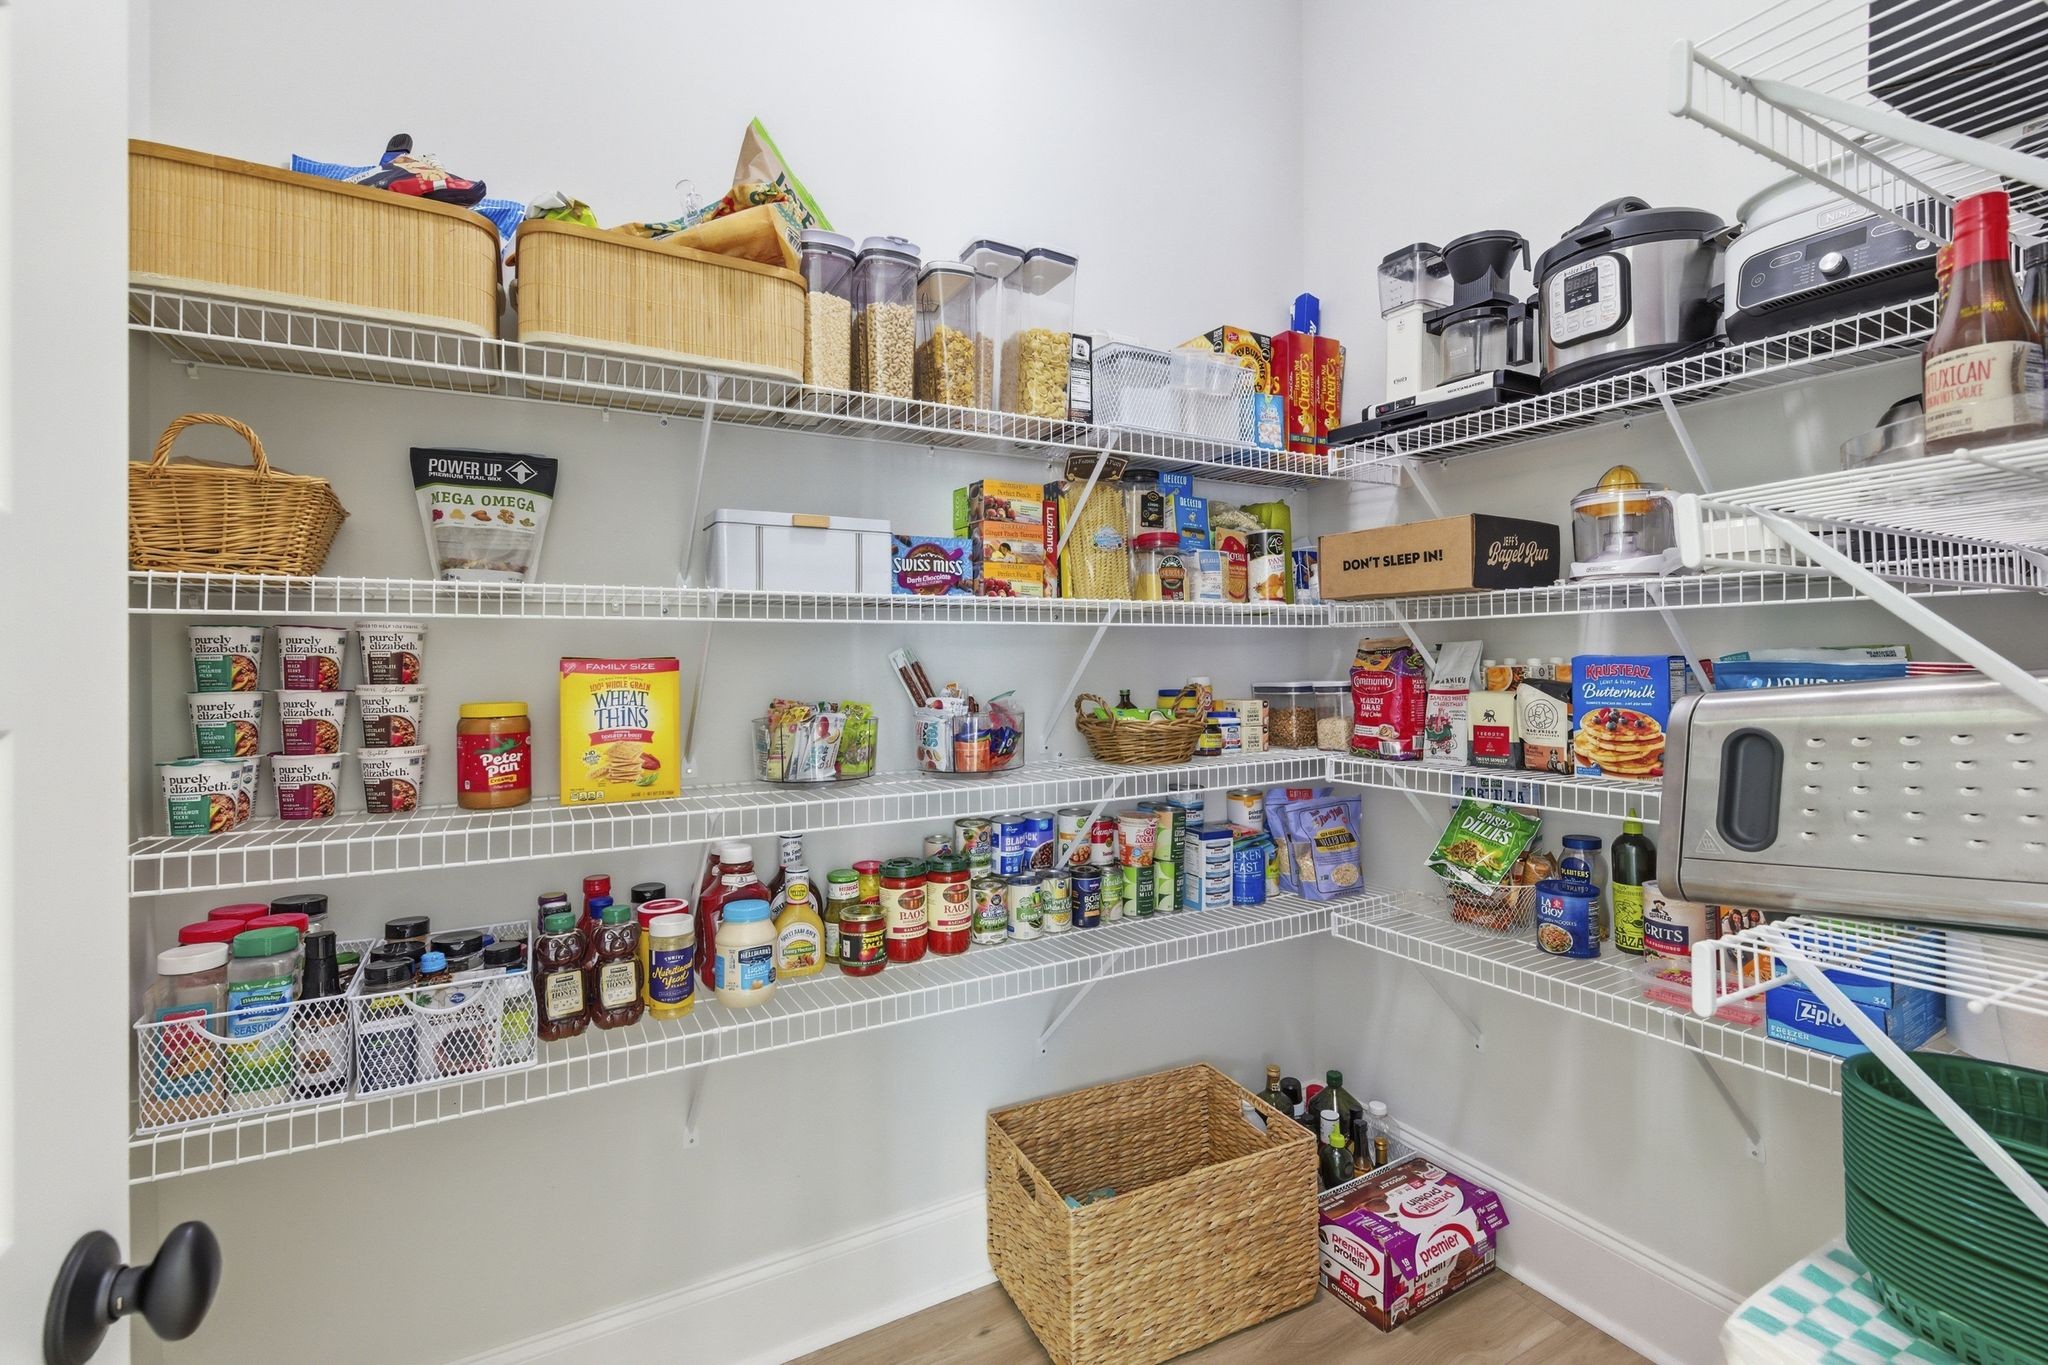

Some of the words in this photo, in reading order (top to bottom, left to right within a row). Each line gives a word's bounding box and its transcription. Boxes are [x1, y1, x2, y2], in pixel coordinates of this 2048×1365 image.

[1826, 207, 1857, 223] NINJA
[428, 458, 480, 476] POWER
[484, 463, 502, 476] UP
[431, 490, 474, 506] MEGA
[481, 494, 536, 513] OMEGA
[1046, 506, 1056, 554] Luzianne
[1502, 534, 1519, 546] JEFF'S
[1343, 556, 1380, 572] DON'T
[1383, 552, 1420, 568] SLEEP
[1423, 549, 1443, 562] IN!
[1487, 541, 1526, 570] Bagel
[1525, 541, 1550, 568] Run
[893, 557, 930, 574] SWISS
[933, 560, 963, 576] MISS
[906, 576, 922, 584] Dark
[922, 574, 951, 582] Chocolate
[194, 635, 232, 648] purely
[286, 636, 322, 648] purely
[369, 634, 404, 644] purely
[586, 662, 628, 670] FAMILY
[630, 662, 655, 670] SIZE
[1586, 663, 1653, 680] KRUSTEAZ
[606, 680, 628, 690] WHOLE
[630, 680, 651, 691] GRAIN
[1354, 676, 1394, 688] Community
[1582, 682, 1656, 699] Buttermilk
[283, 700, 318, 712] purely
[592, 690, 650, 708] WHEAT
[197, 702, 236, 716] purely
[480, 752, 523, 766] Peter
[278, 765, 314, 778] purely
[486, 762, 520, 778] Pan
[169, 774, 210, 788] purely
[490, 776, 514, 784] Creamy
[1477, 810, 1514, 830] CRISPY
[1461, 816, 1512, 844] DILLIES
[1006, 836, 1024, 846] BLAC
[1234, 862, 1258, 872] EAST
[944, 902, 970, 914] RAO'S
[1541, 896, 1552, 908] LA
[1541, 906, 1564, 918] CHOY
[1649, 912, 1672, 922] QUAKER
[1644, 922, 1684, 942] GRITS
[740, 948, 772, 960] HELLMANN'S
[1873, 996, 1887, 1006] 34
[1800, 1002, 1845, 1026] Ziplo
[234, 1024, 276, 1036] SEASON
[1406, 1187, 1442, 1206] protein
[1416, 1192, 1455, 1214] premier
[1332, 1234, 1370, 1263] premier
[1419, 1233, 1460, 1267] premier
[1334, 1245, 1366, 1272] protein
[1331, 1283, 1366, 1312] CHOCOLATE
